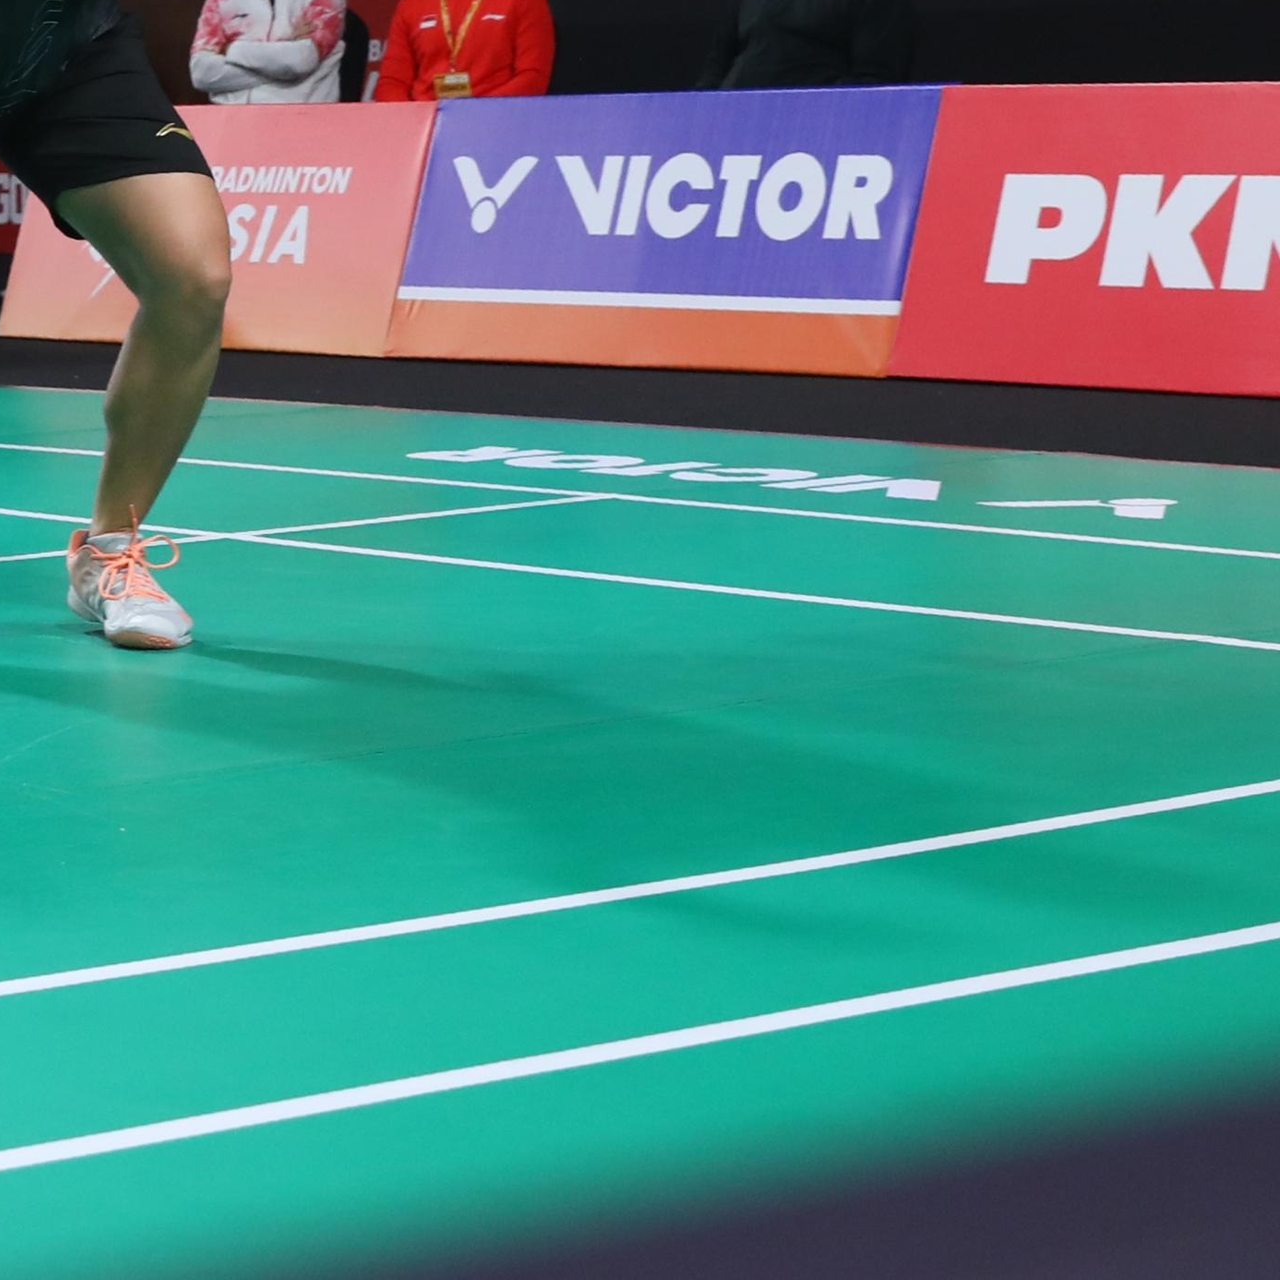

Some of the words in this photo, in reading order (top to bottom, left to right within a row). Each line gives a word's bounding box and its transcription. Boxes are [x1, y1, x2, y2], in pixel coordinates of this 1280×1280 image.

[555, 152, 894, 242] VICTOR
[227, 203, 309, 265] SIA
[406, 446, 941, 501] VICTOR
